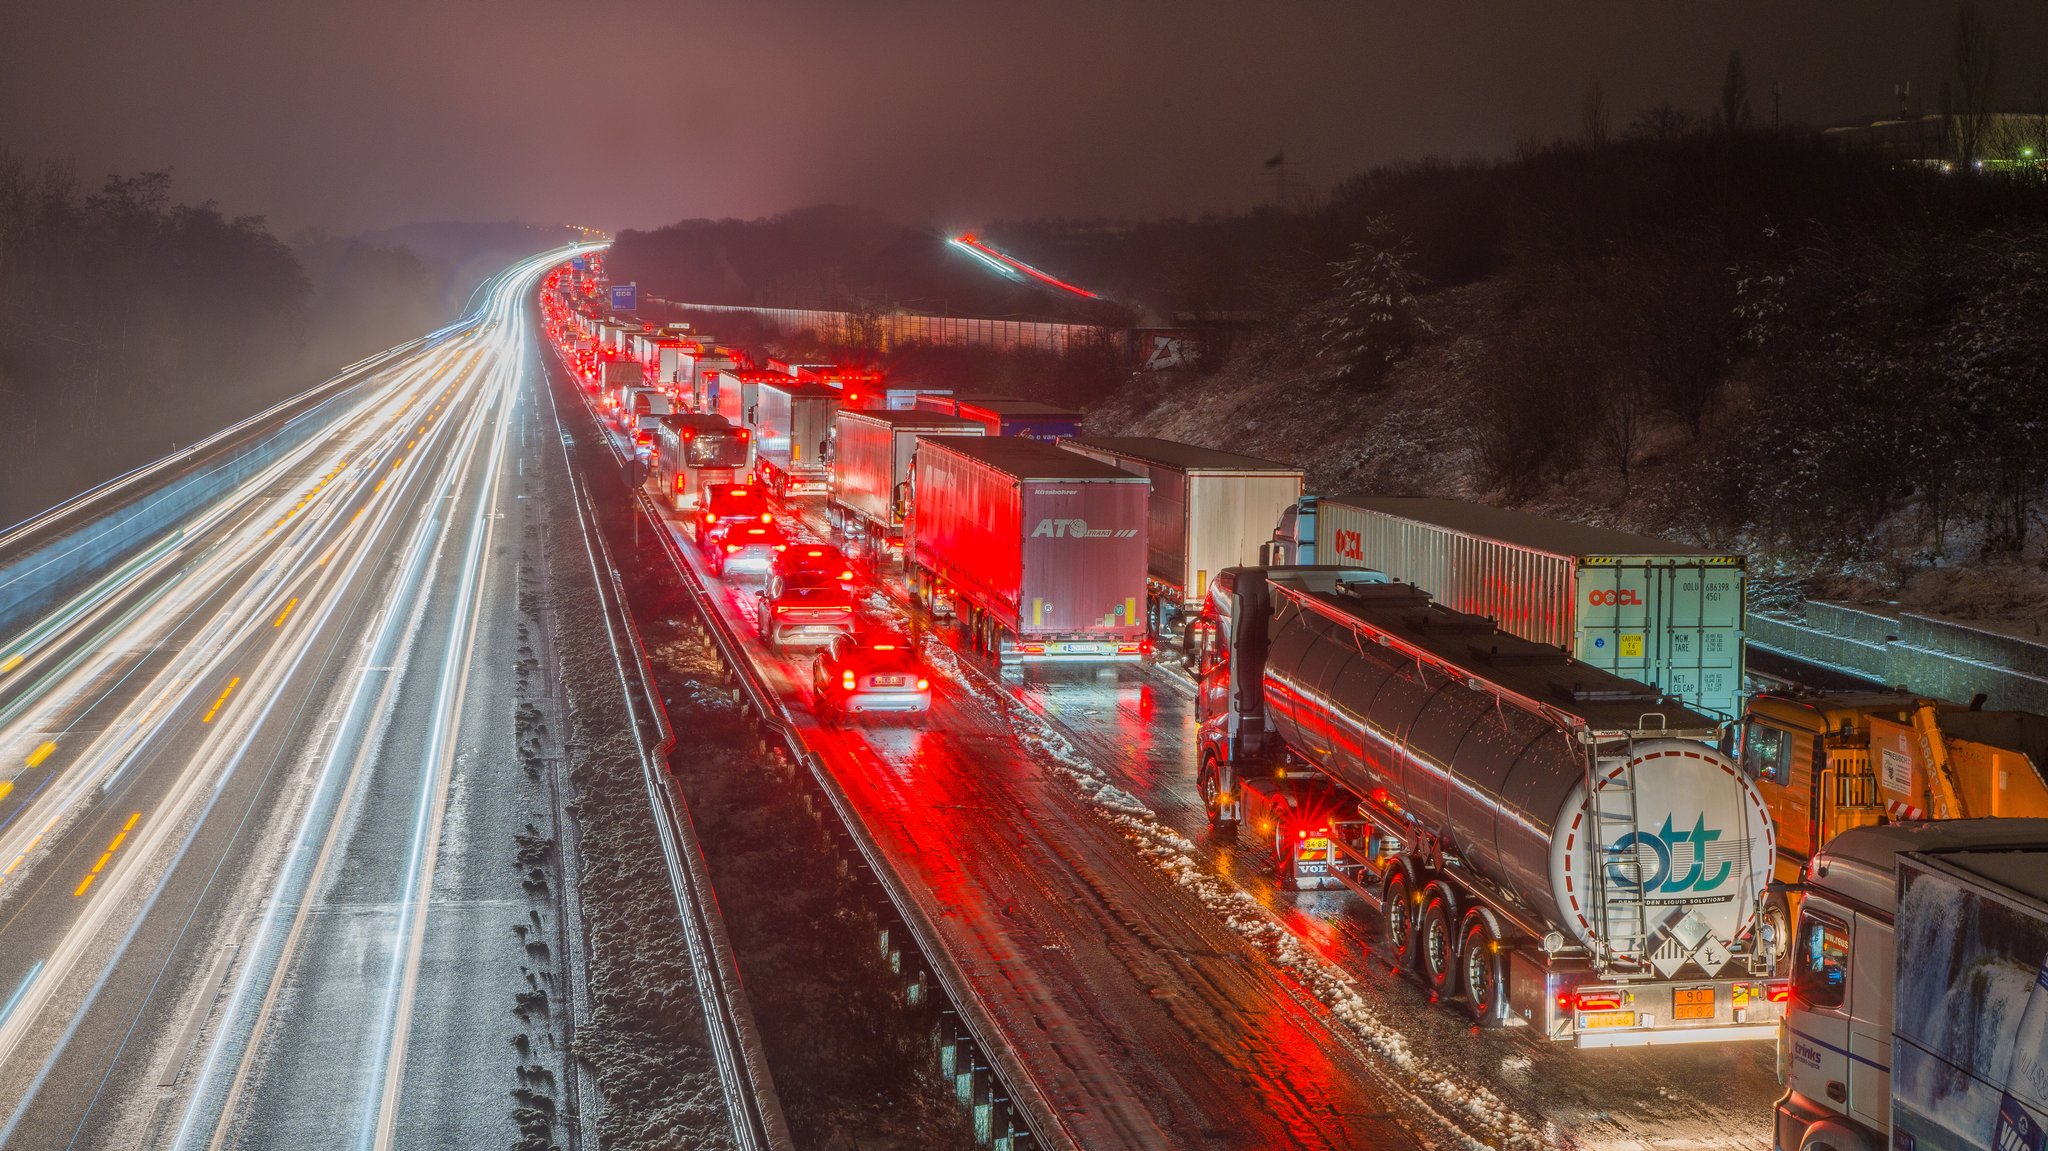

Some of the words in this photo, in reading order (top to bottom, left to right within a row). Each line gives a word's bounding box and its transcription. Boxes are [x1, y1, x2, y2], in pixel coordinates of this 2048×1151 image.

[1705, 583, 1730, 592] 686398
[1589, 590, 1642, 606] OOCL
[1705, 593, 1721, 602] 45G1
[1298, 864, 1345, 873] VOLO
[1689, 896, 1726, 904] SOLUTIONS
[1687, 990, 1703, 1003] 90
[1678, 1005, 1713, 1018] 3082
[1795, 1041, 1822, 1064] trinks
